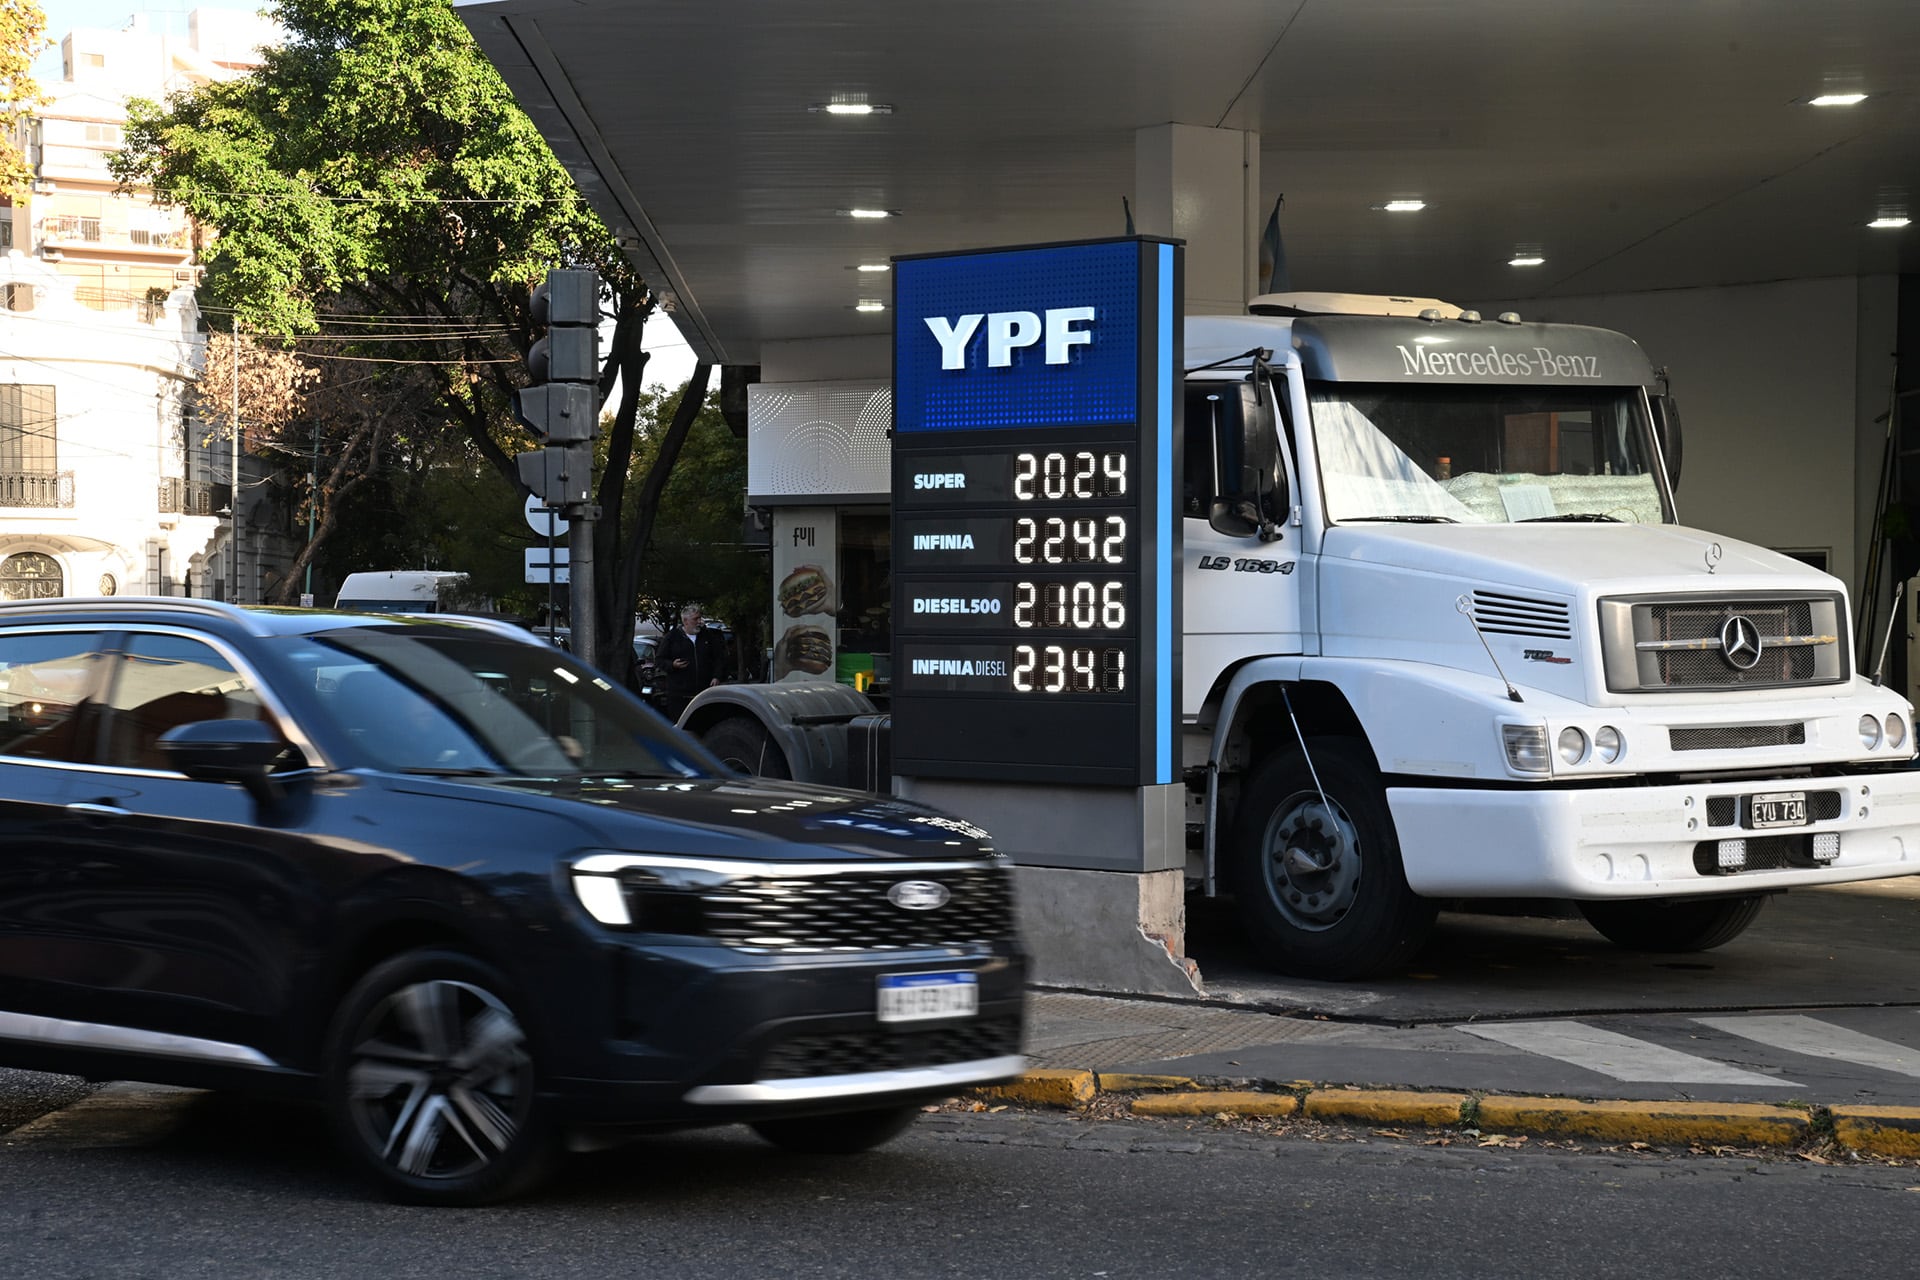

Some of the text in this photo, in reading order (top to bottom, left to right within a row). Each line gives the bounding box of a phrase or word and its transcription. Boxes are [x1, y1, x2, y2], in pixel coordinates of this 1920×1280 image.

[923, 306, 1095, 370] YPF
[1396, 345, 1602, 378] Mercedes-Benz
[914, 452, 1126, 500] SUPER 2024
[793, 527, 815, 547] full
[913, 516, 1126, 564] INFINIA 2242
[1198, 556, 1295, 575] LS 1634
[1014, 582, 1126, 629] 2106
[912, 645, 1125, 692] INFINIA DIESEL 2341
[1754, 801, 1804, 822] EYU 734
